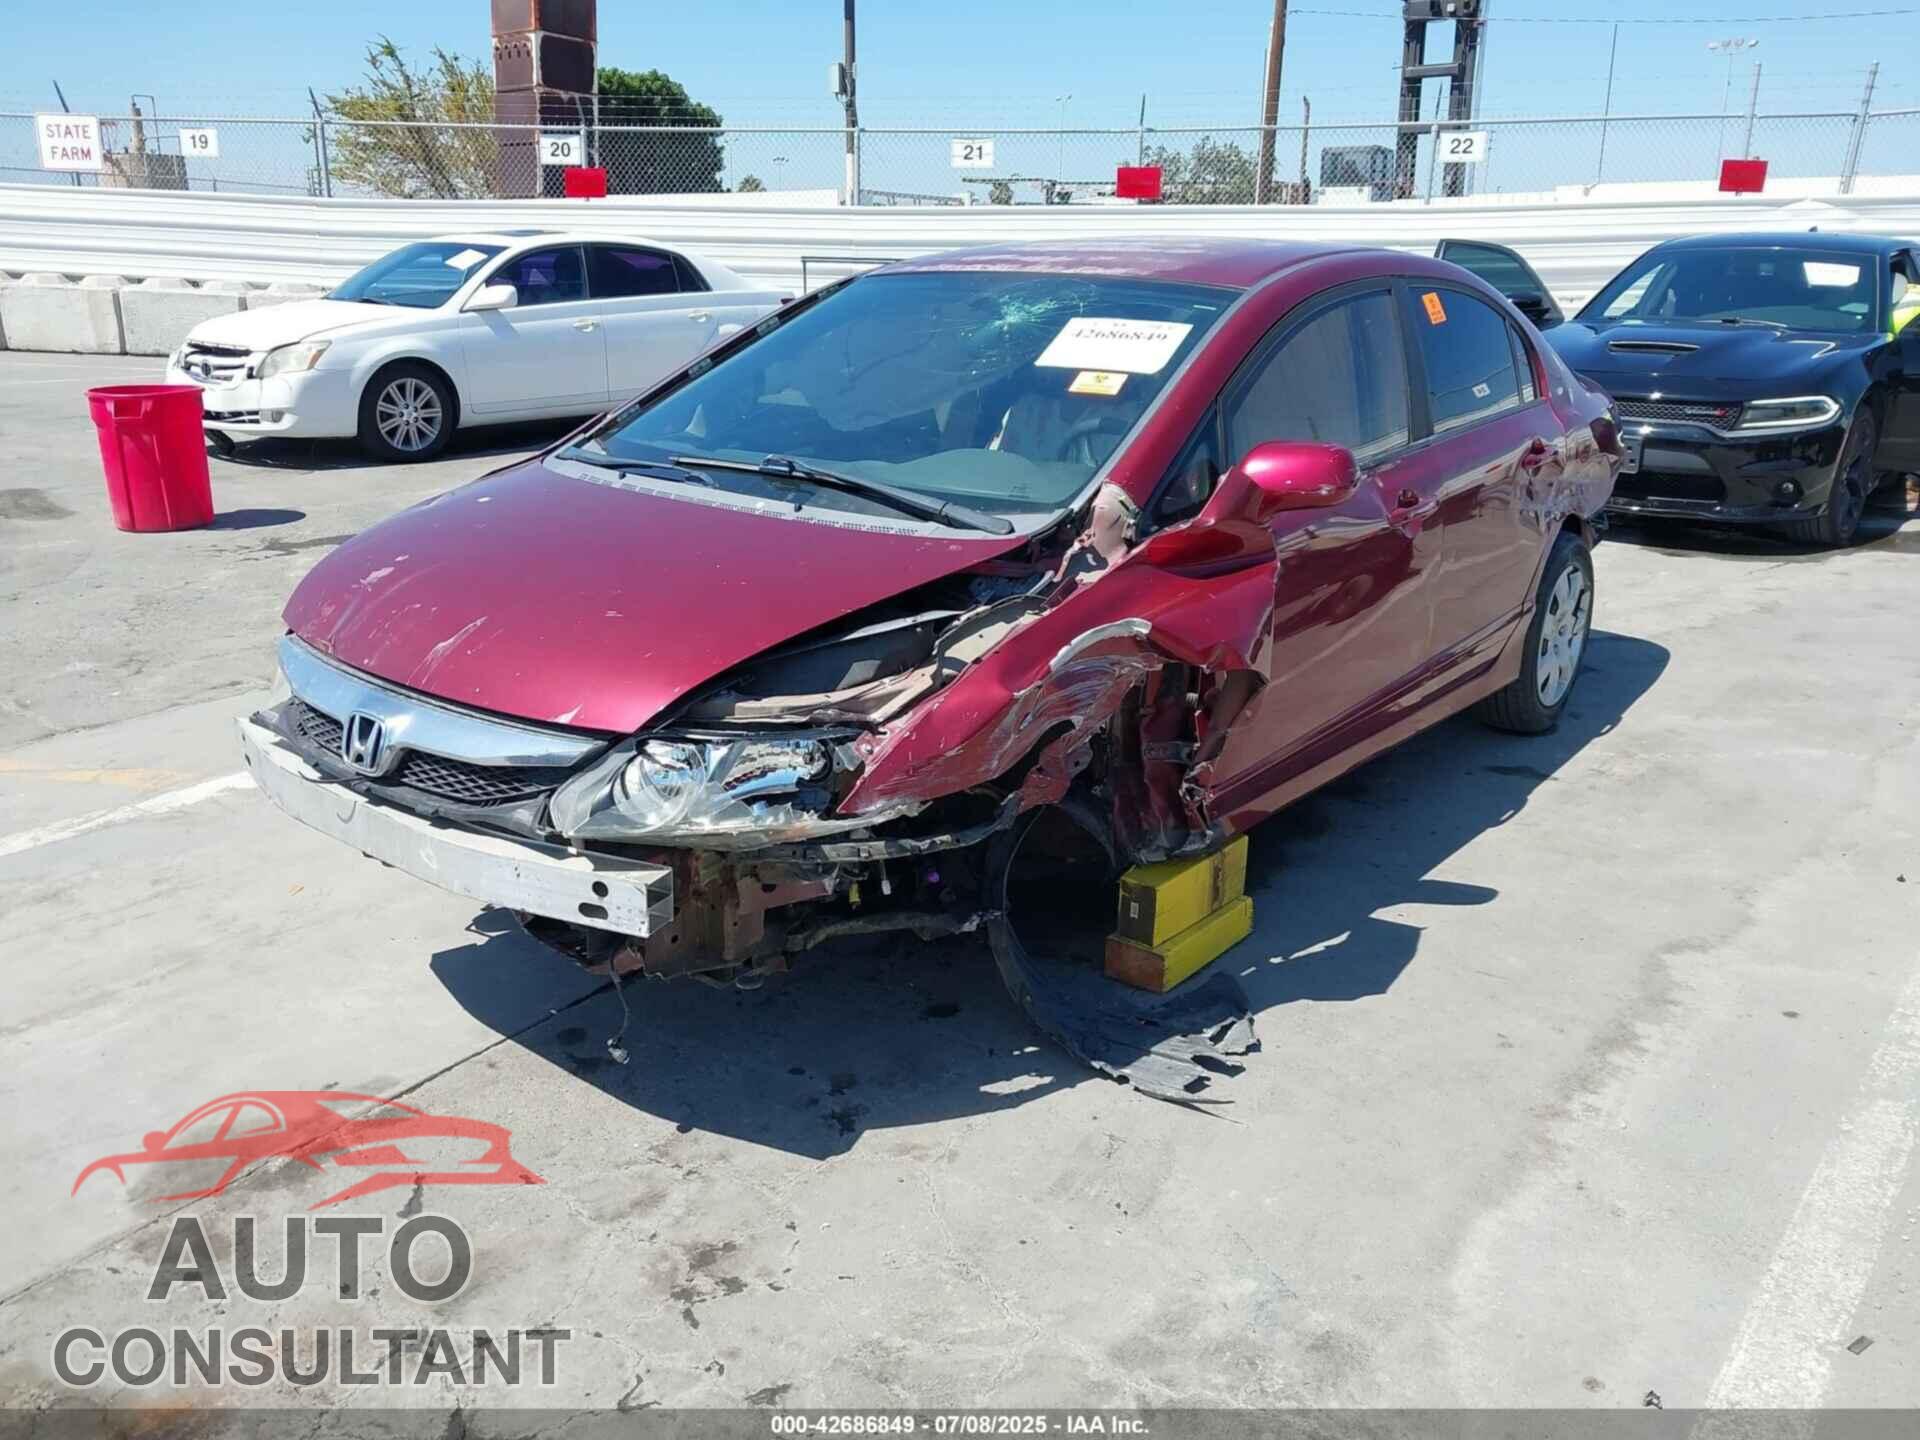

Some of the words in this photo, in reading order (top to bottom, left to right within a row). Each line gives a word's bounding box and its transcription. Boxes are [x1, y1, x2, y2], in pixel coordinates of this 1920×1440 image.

[46, 123, 92, 140] STATE
[189, 133, 209, 150] 19
[550, 141, 571, 157] 20
[1449, 138, 1474, 154] 22
[50, 146, 92, 161] FARM
[963, 144, 984, 161] 21
